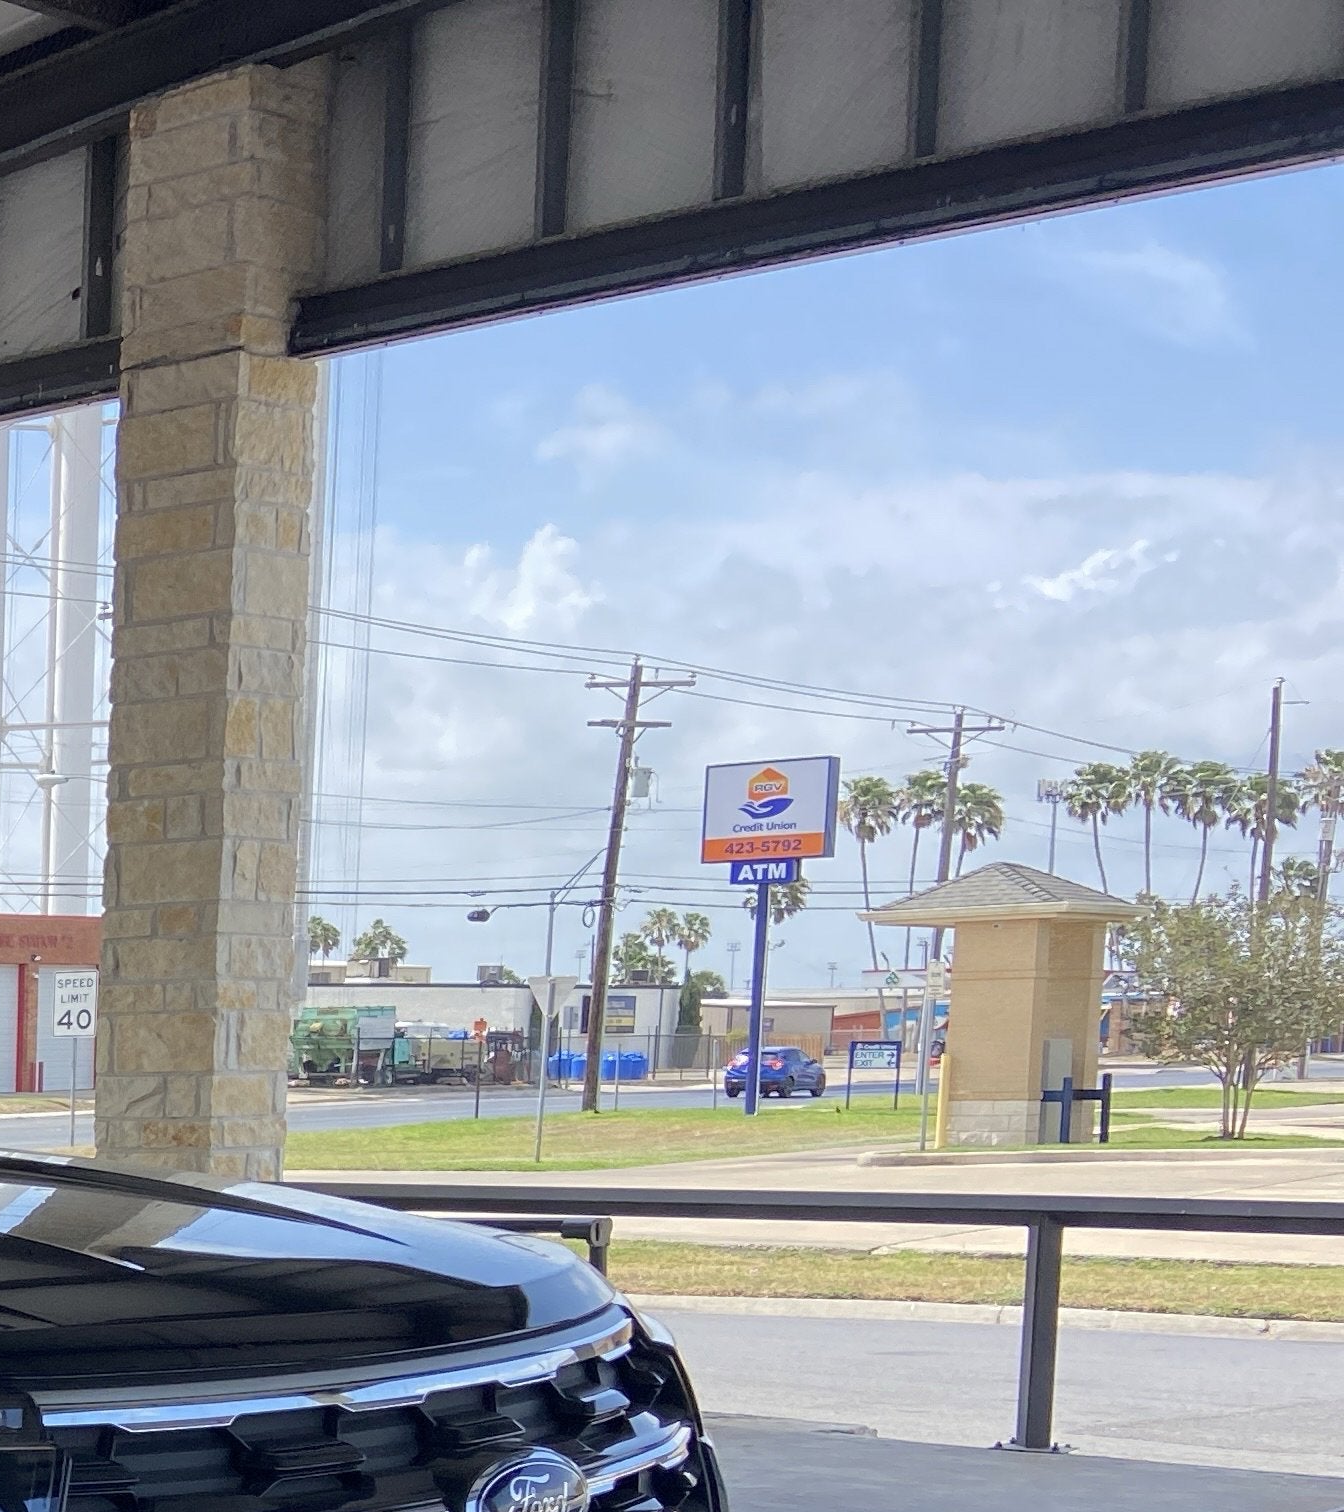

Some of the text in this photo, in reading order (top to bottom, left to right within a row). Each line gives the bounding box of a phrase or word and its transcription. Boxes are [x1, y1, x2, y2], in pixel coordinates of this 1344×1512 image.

[754, 783, 782, 792] RGV
[732, 821, 797, 833] Credit Union
[724, 839, 803, 855] 423-5792
[738, 862, 787, 881] ATM
[57, 978, 94, 988] SPEED
[60, 993, 89, 1003] LIMIT
[57, 1009, 92, 1030] 40
[855, 1051, 885, 1059] ENTER
